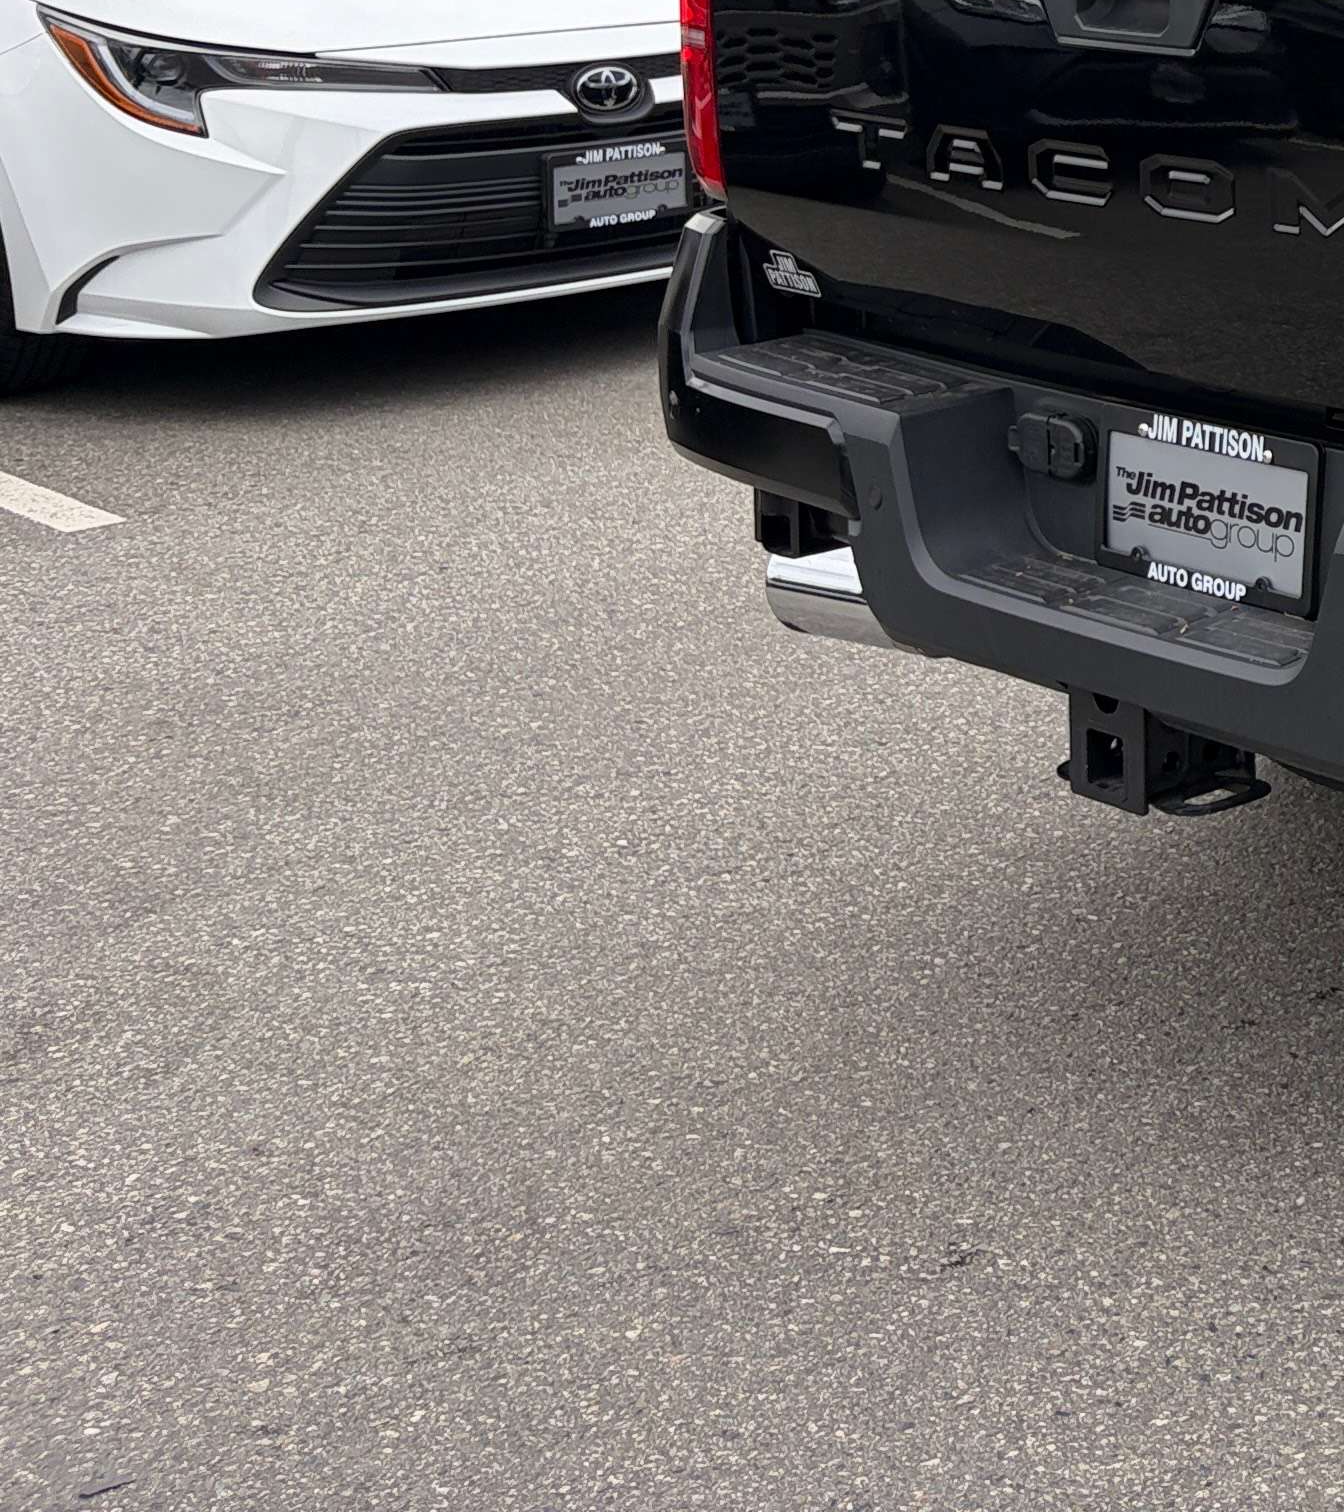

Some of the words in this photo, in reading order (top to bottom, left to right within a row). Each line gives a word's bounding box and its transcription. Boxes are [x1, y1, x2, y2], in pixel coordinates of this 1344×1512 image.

[583, 148, 603, 165] JIM
[606, 141, 661, 162] PATTISON
[590, 214, 618, 228] AUTO
[620, 209, 656, 224] GROUP
[776, 255, 796, 273] JIM
[768, 268, 818, 292] PATTISON
[1148, 414, 1179, 445] JIM
[1182, 420, 1265, 463] PATTISON
[1116, 466, 1137, 481] The
[1147, 562, 1189, 588] AUTO
[1191, 573, 1247, 602] GROUP
